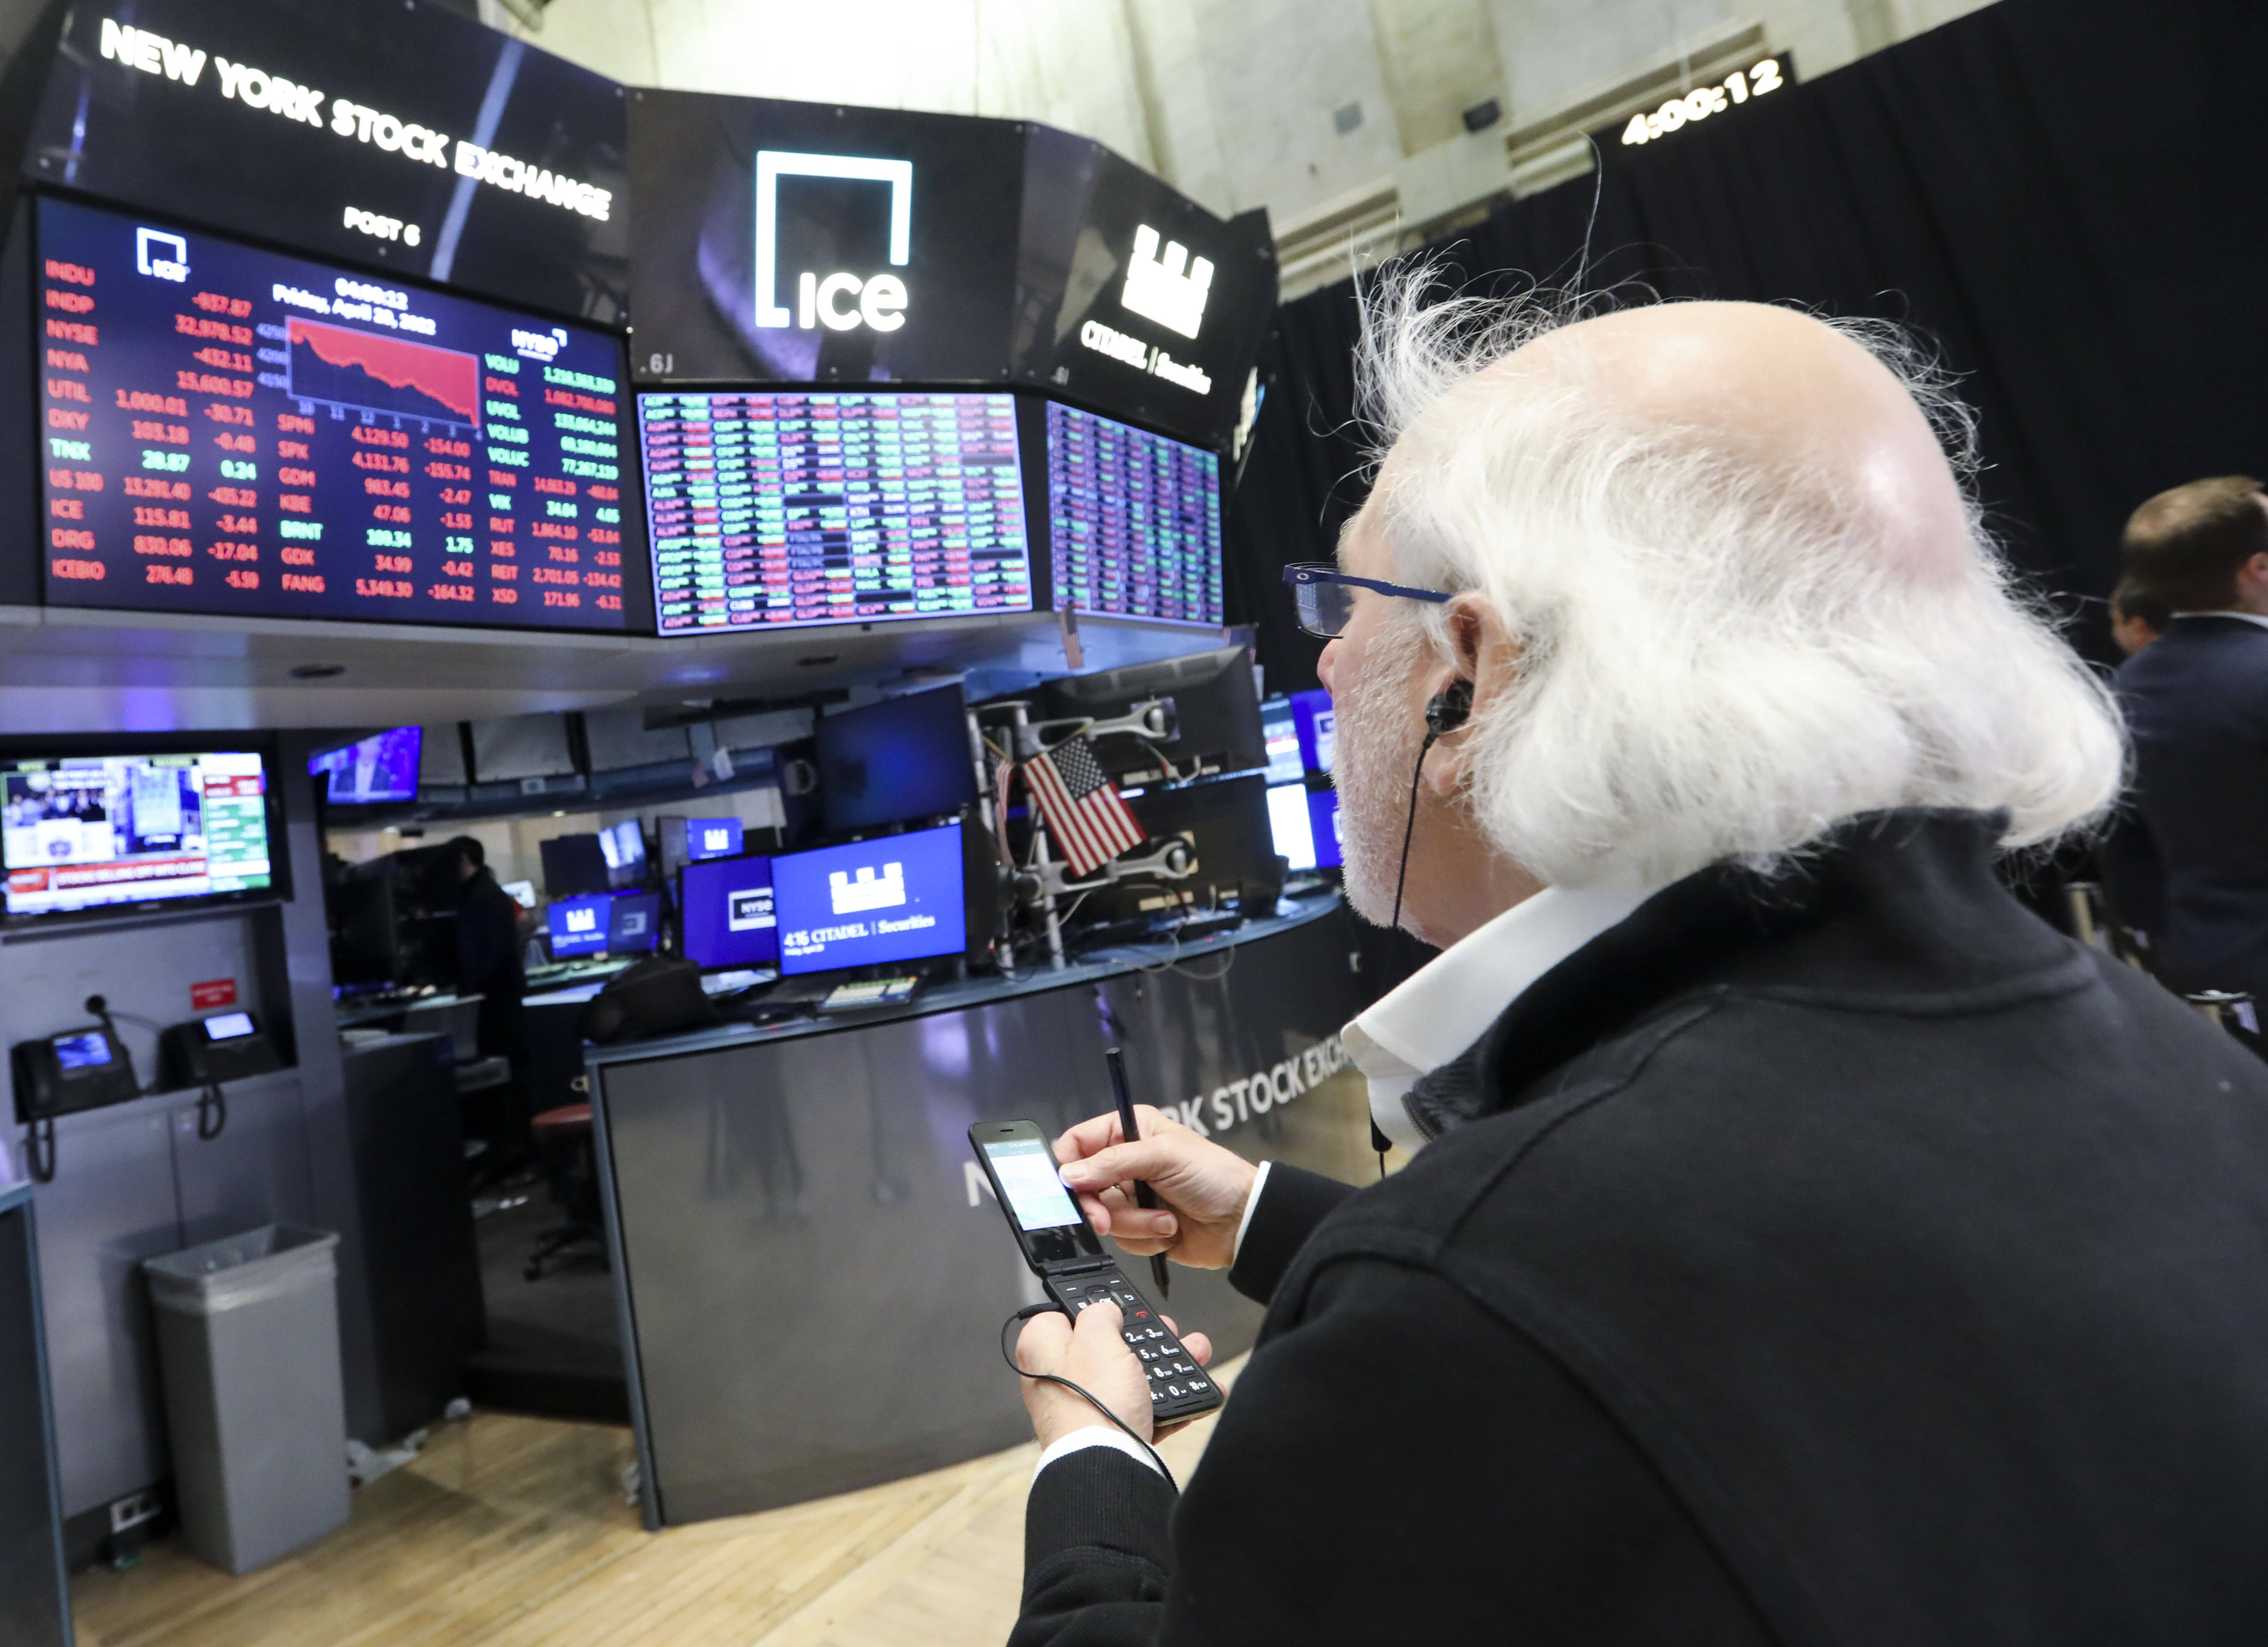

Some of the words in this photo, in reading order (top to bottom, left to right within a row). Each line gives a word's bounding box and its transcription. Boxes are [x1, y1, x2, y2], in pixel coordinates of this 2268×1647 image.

[1622, 59, 1783, 145] 4:00:12
[100, 18, 206, 86] NEW
[215, 56, 325, 128] YORK
[330, 99, 448, 168] STOCK
[454, 140, 612, 221] EXCHANGE
[344, 206, 402, 242] POST
[402, 224, 420, 246] 6
[46, 261, 95, 286] INDU
[46, 290, 95, 313] INDP
[47, 319, 98, 345] NYSE
[47, 349, 89, 372] NYA
[485, 353, 520, 374] VOLU
[47, 378, 92, 402] UTIL
[486, 377, 518, 396] DVOL
[49, 408, 90, 430] DXY
[486, 400, 521, 420] UVOL
[487, 423, 529, 444] VOLUB
[49, 438, 91, 461] TNX
[220, 460, 257, 480] 0.24
[278, 440, 309, 459] SPX
[487, 446, 530, 467] VOLUC
[279, 467, 316, 486] GDM
[440, 488, 472, 504] -2.47
[489, 470, 516, 486] TRAN
[489, 493, 511, 510] VIX
[51, 499, 84, 520] ICE
[134, 506, 191, 529] 115.81
[216, 515, 257, 534] -3.44
[490, 517, 515, 533] RUT
[52, 528, 95, 550] DRG
[208, 542, 258, 561] -17.04
[280, 520, 323, 540] BRNT
[446, 536, 474, 553] 1.75
[281, 547, 314, 565] GDX
[491, 541, 515, 557] XES
[491, 564, 518, 580] REIT
[282, 574, 325, 593] FANG
[492, 588, 518, 603] XSD
[811, 923, 869, 943] CITADEL
[878, 914, 935, 934] Securities
[1211, 1055, 1306, 1131] STOCK
[1125, 1332, 1136, 1342] 2
[1146, 1328, 1156, 1338] 3
[1139, 1349, 1150, 1359] 5
[1160, 1345, 1169, 1355] 6
[1153, 1367, 1165, 1378] 8
[1173, 1363, 1183, 1373] 9
